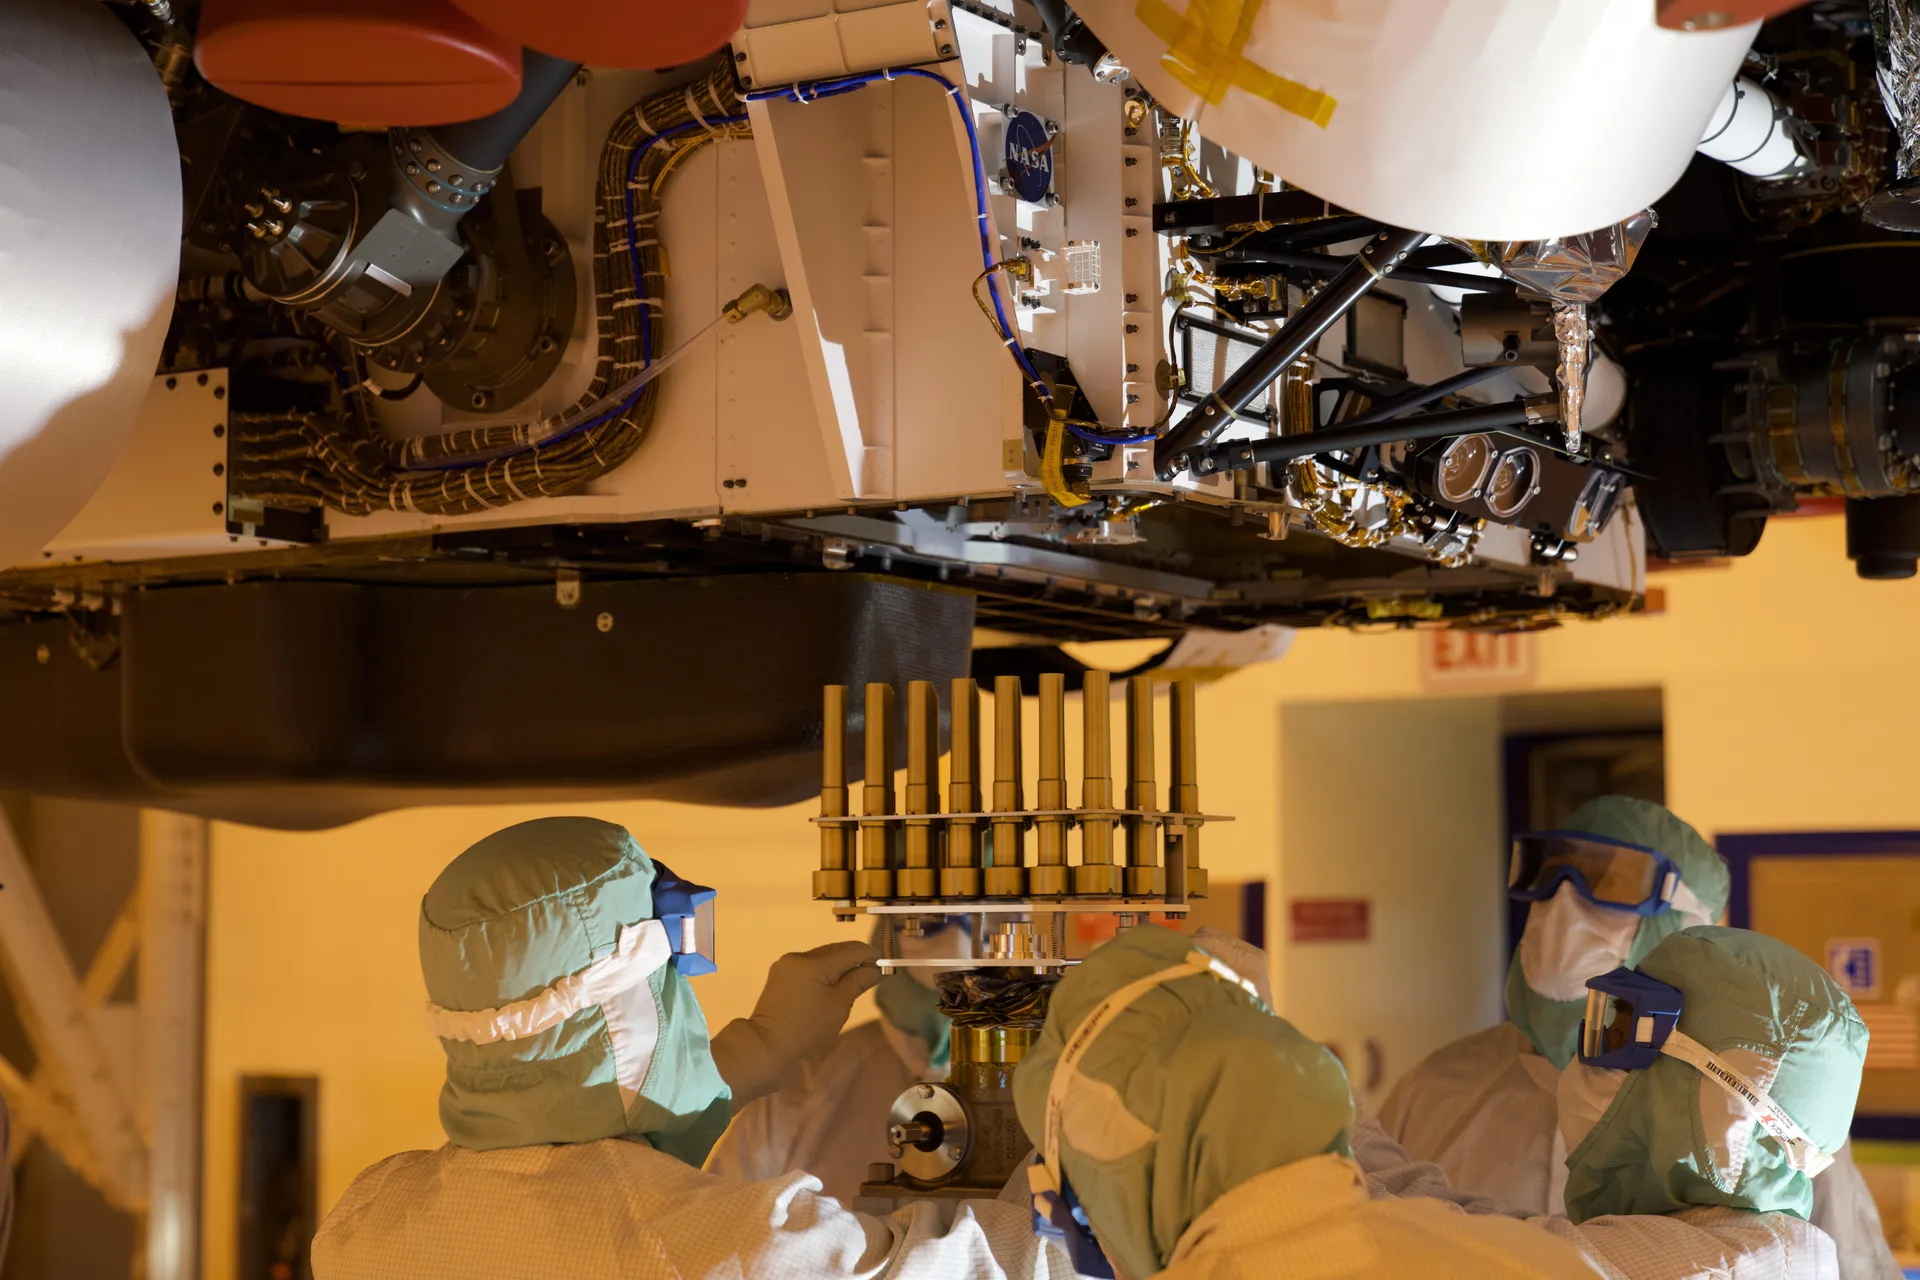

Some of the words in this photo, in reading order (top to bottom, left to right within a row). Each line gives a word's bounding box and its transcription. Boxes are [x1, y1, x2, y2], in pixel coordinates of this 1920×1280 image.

[1009, 142, 1049, 173] NASA
[1050, 421, 1059, 446] flight
[1047, 448, 1055, 479] before
